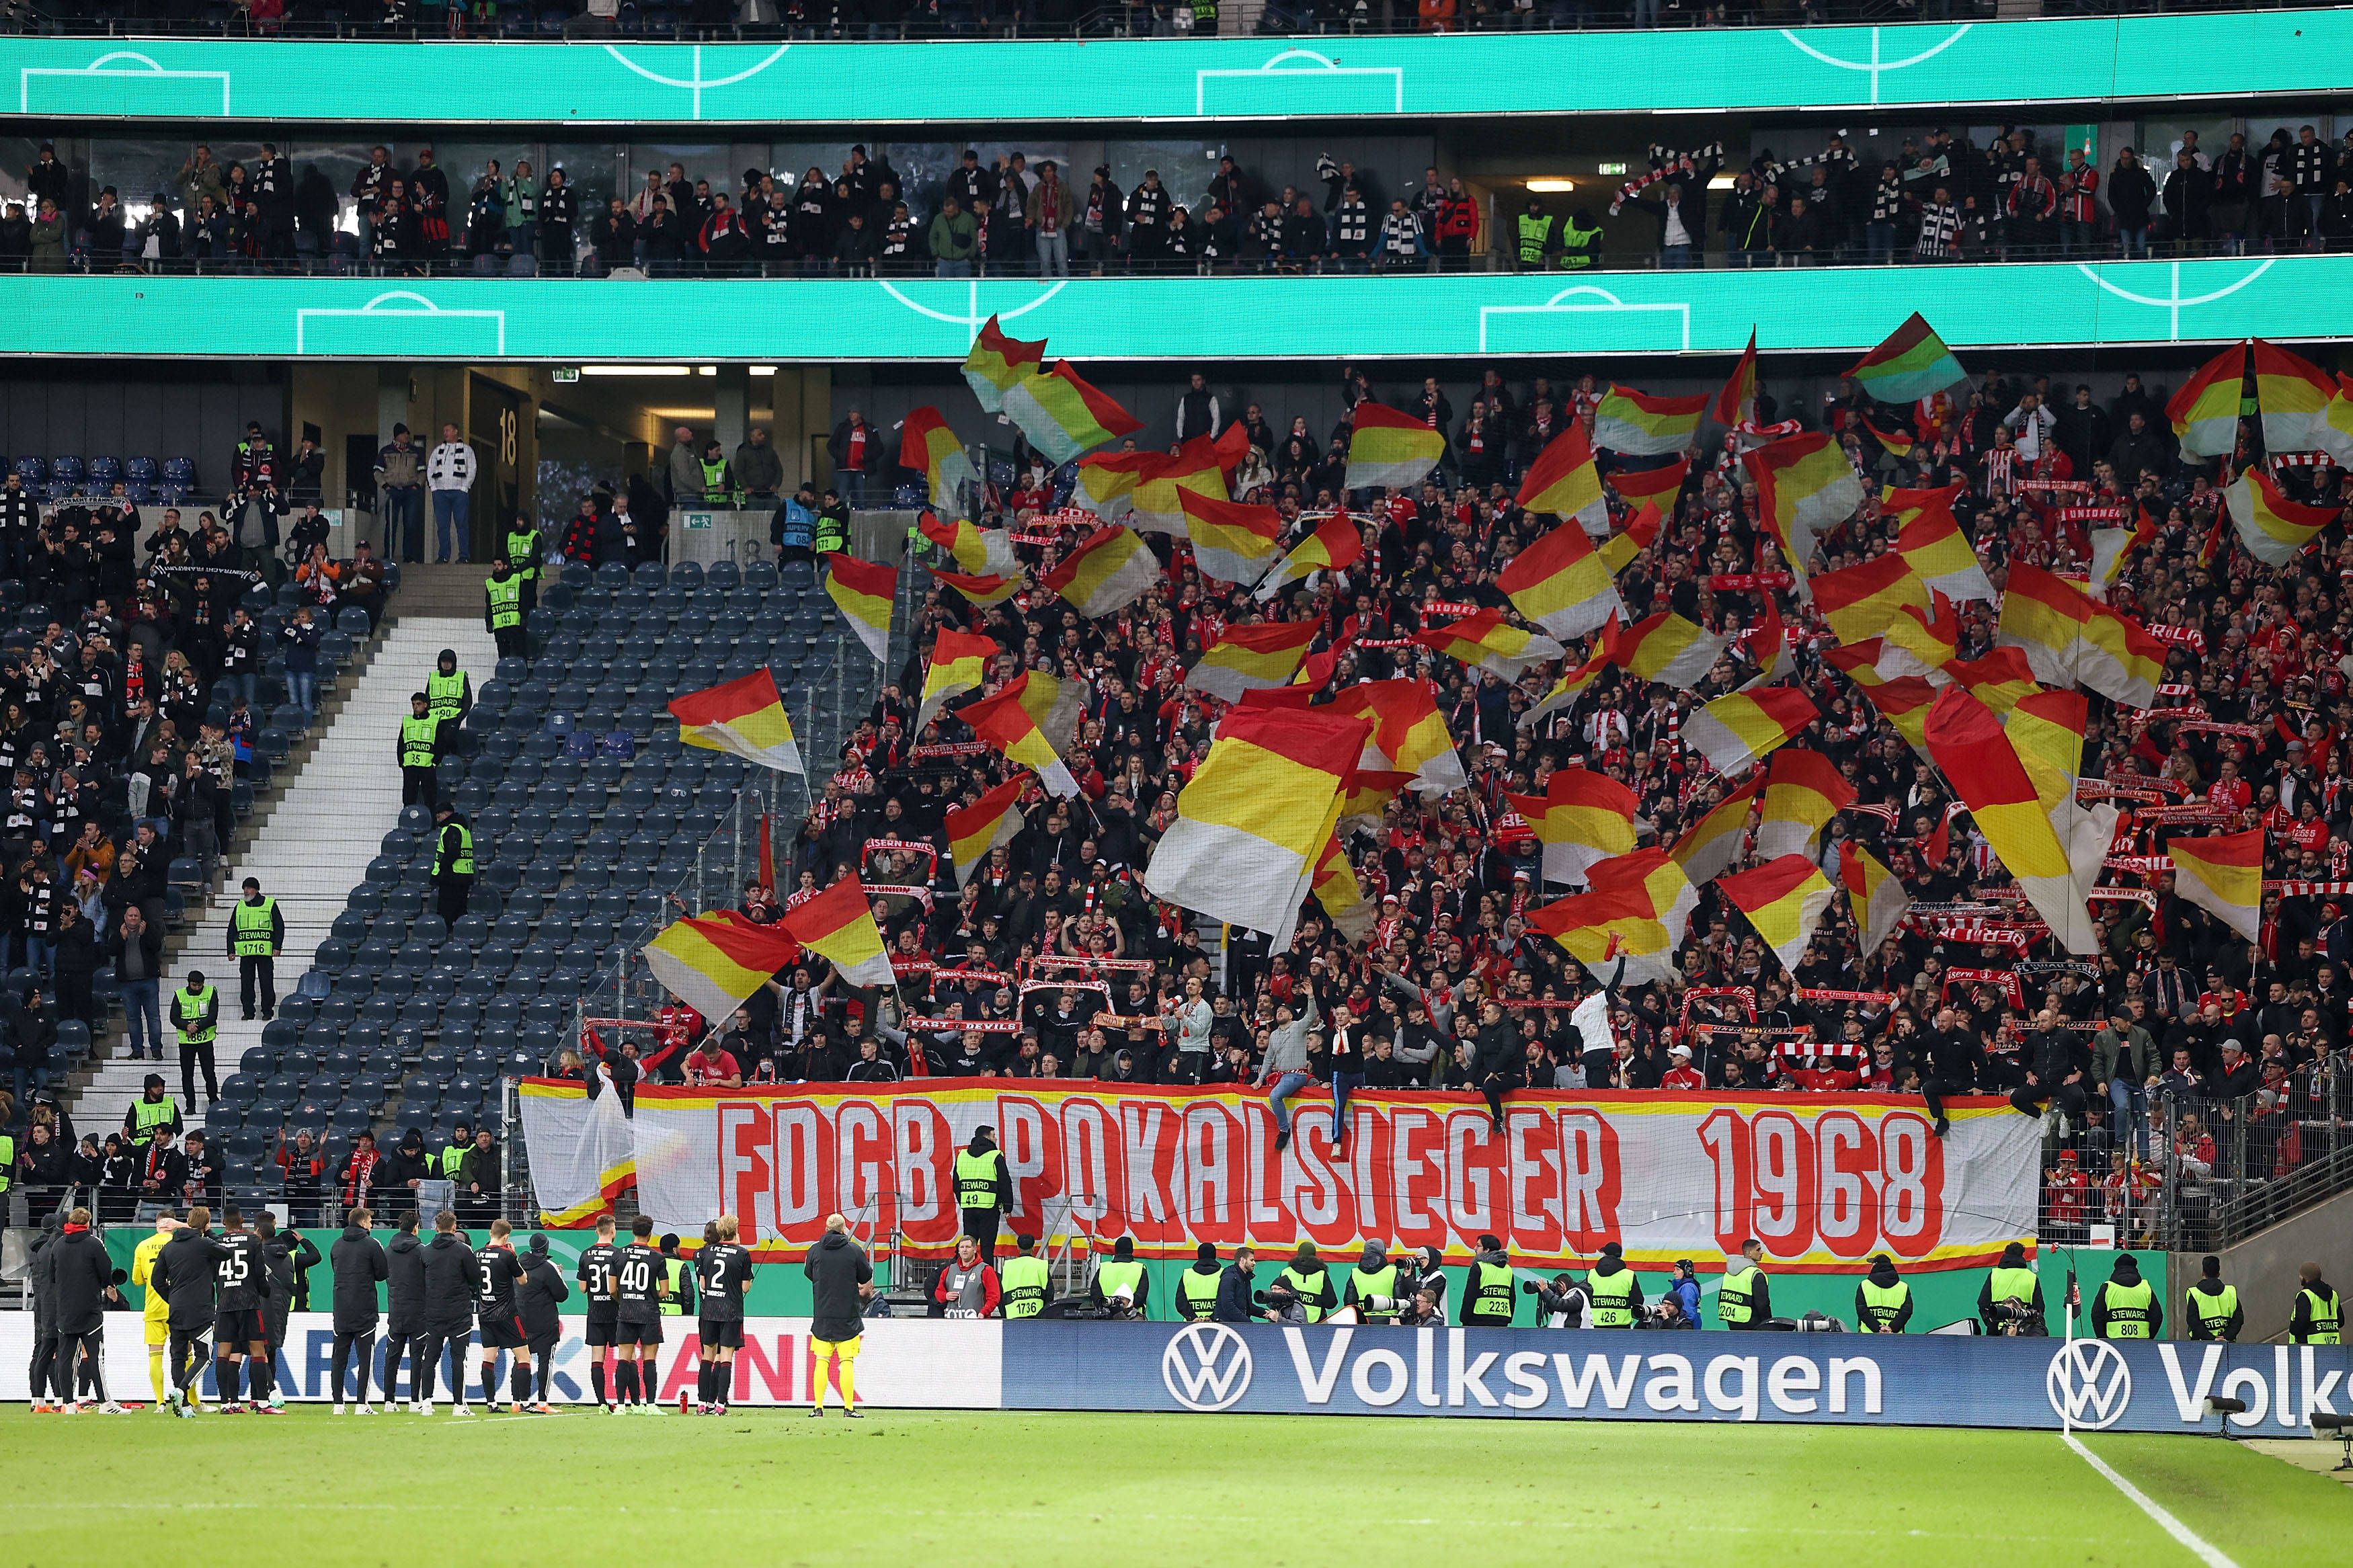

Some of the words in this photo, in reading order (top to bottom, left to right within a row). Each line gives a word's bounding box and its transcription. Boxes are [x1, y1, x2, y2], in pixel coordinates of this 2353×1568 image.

[500, 408, 516, 466] 18
[1425, 603, 1477, 616] NIONER
[1911, 903, 1956, 912] BERLIN
[238, 932, 271, 940] STEWARD
[243, 943, 265, 954] 1716
[912, 962, 932, 971] NIX
[2068, 963, 2100, 979] BERLIN
[1732, 986, 1757, 1010] Union
[1096, 1016, 1118, 1026] UNION
[1698, 1108, 1944, 1257] 1968
[218, 1249, 249, 1280] 45
[480, 1266, 492, 1294] 3
[588, 1264, 610, 1293] 31
[620, 1261, 649, 1292] 40
[711, 1259, 726, 1289] 2
[223, 1280, 242, 1288] JORDAN
[594, 1294, 612, 1302] KNOCHE
[623, 1292, 645, 1301] LEWELING
[707, 1290, 726, 1298] THORSBY
[1011, 1288, 1042, 1301] STEWARD
[1016, 1302, 1037, 1314] 1736
[1488, 1301, 1509, 1313] 2236
[1593, 1298, 1627, 1307] STEWARD
[2112, 1310, 2145, 1319] STEWARD
[2120, 1324, 2139, 1336] 808
[1283, 1327, 1882, 1421] Volkswagen
